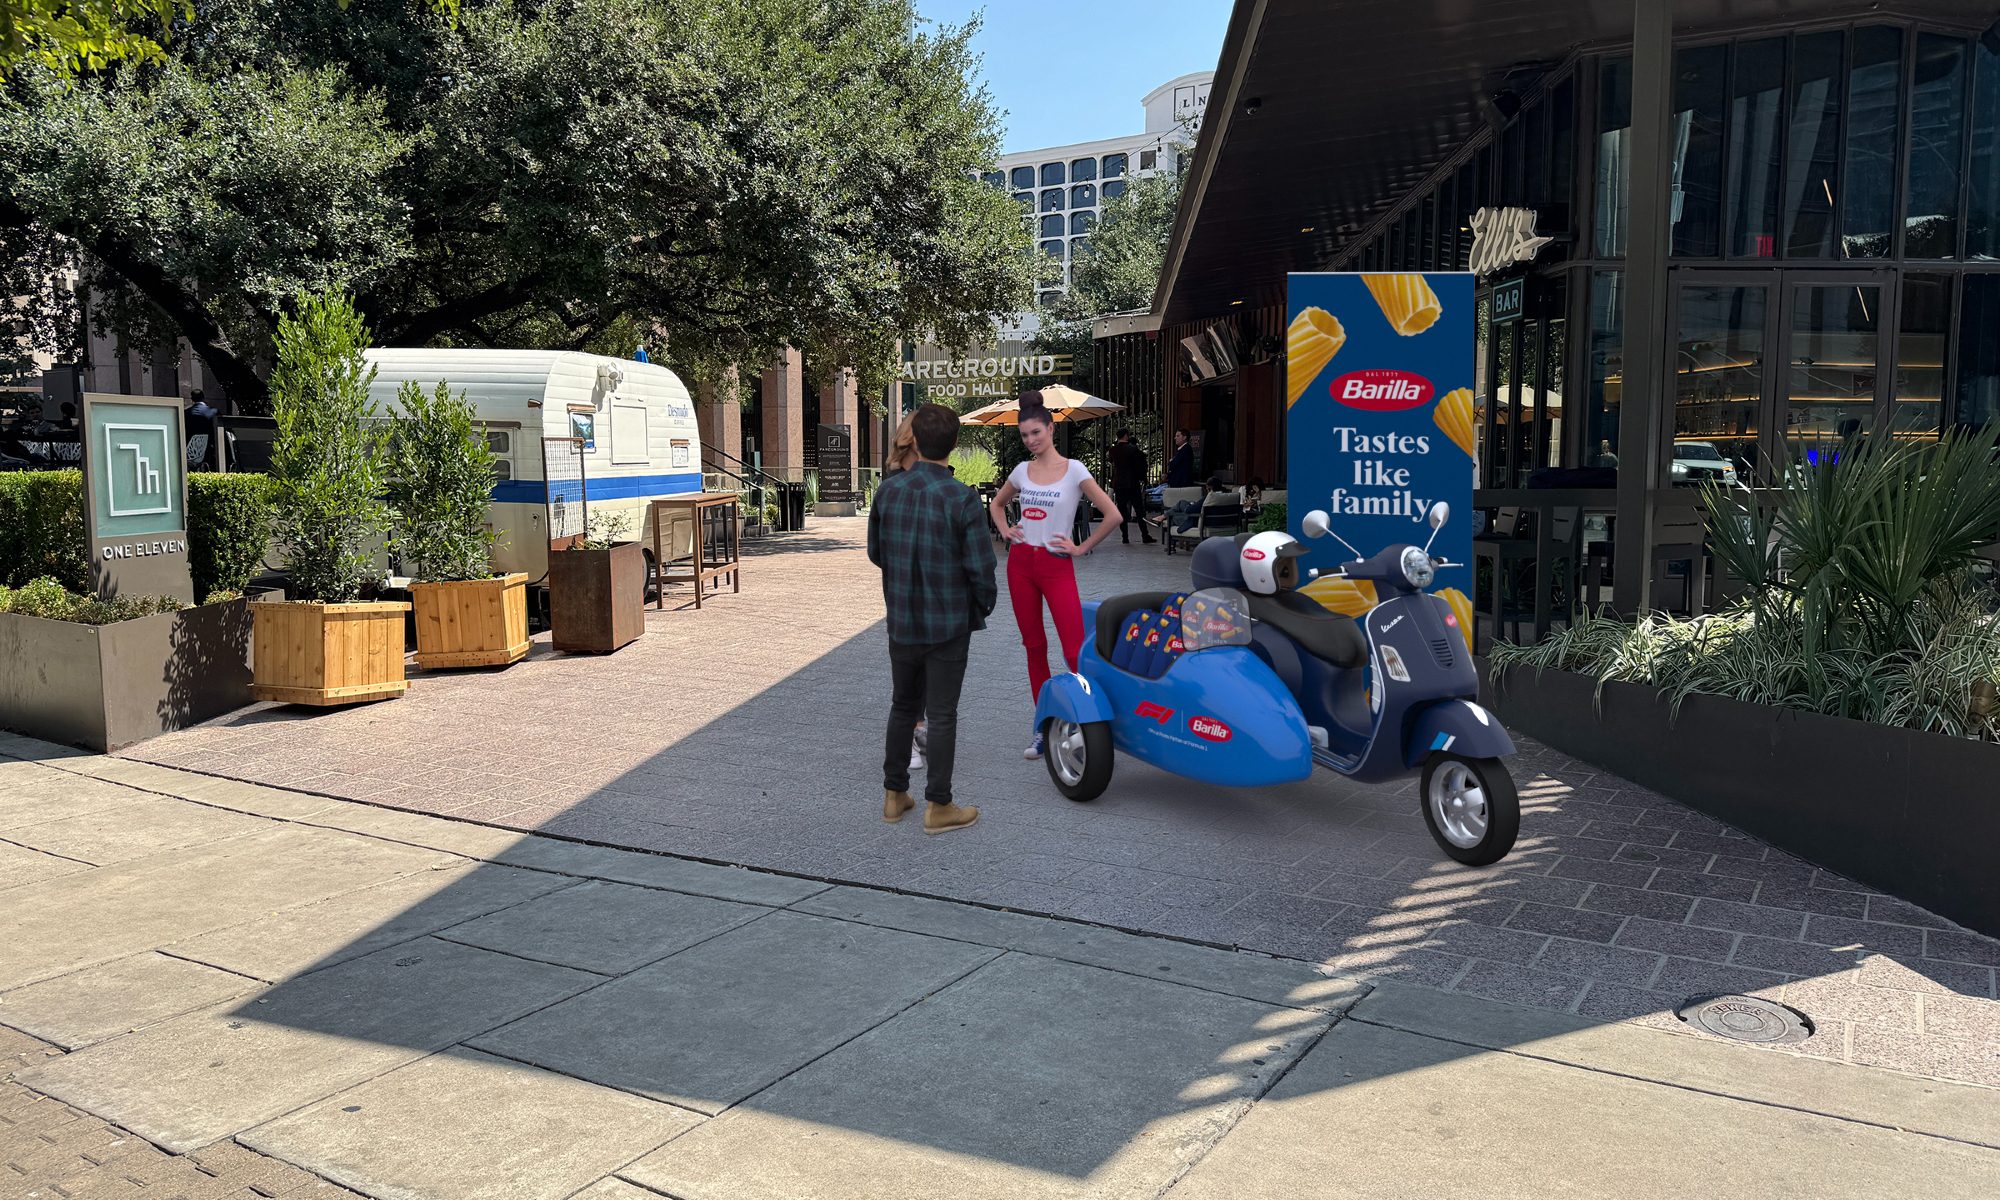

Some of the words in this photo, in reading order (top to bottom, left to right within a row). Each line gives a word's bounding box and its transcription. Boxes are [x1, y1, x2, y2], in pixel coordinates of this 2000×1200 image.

[1496, 289, 1519, 312] BAR
[903, 355, 1055, 380] AREGROUND
[928, 383, 966, 397] FOOD
[972, 382, 1009, 396] HALL
[1342, 379, 1421, 400] Barilla
[1333, 427, 1430, 454] Tastes
[1353, 459, 1410, 487] like
[1331, 488, 1432, 522] family
[102, 545, 132, 559] ONE
[136, 540, 185, 556] ELEVEN
[1193, 719, 1227, 739] Barilla
[1708, 1003, 1764, 1016] SEWER
